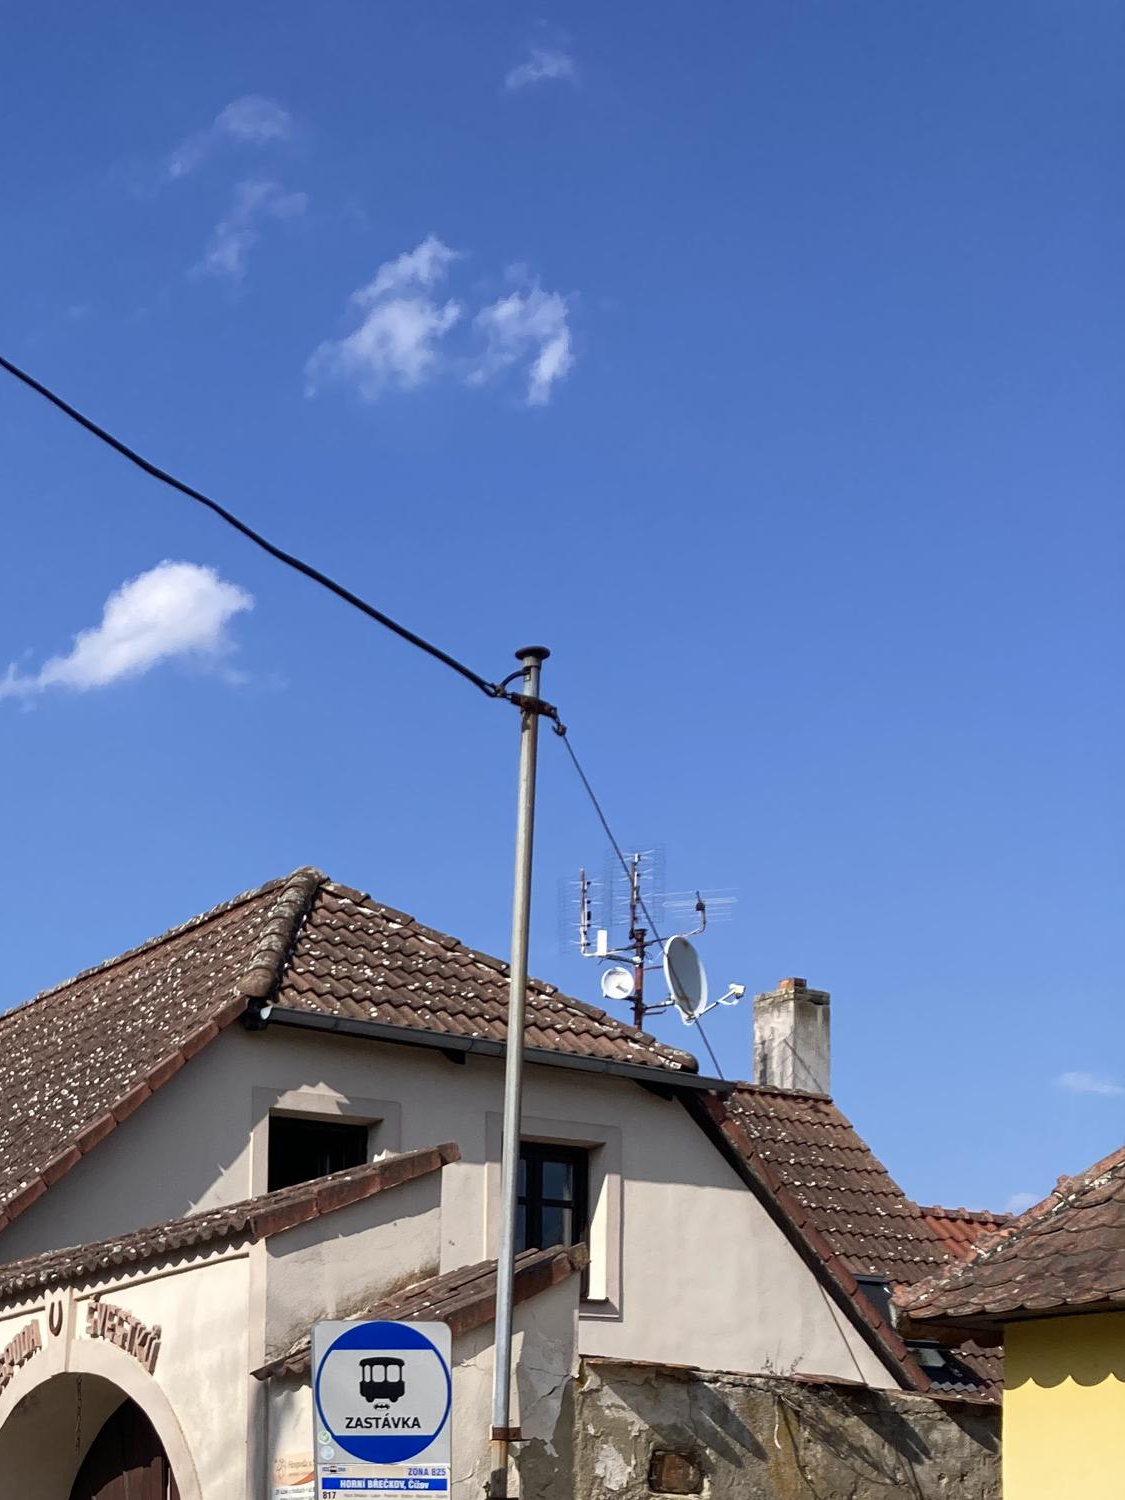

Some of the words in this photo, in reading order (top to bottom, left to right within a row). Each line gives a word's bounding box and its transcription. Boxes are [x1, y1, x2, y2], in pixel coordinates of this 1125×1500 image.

[49, 1300, 63, 1337] U
[345, 1413, 421, 1429] ZASTÁVKA
[408, 1467, 429, 1476] ZONA
[339, 1478, 366, 1489] HORNÍ
[322, 1491, 337, 1499] 817
